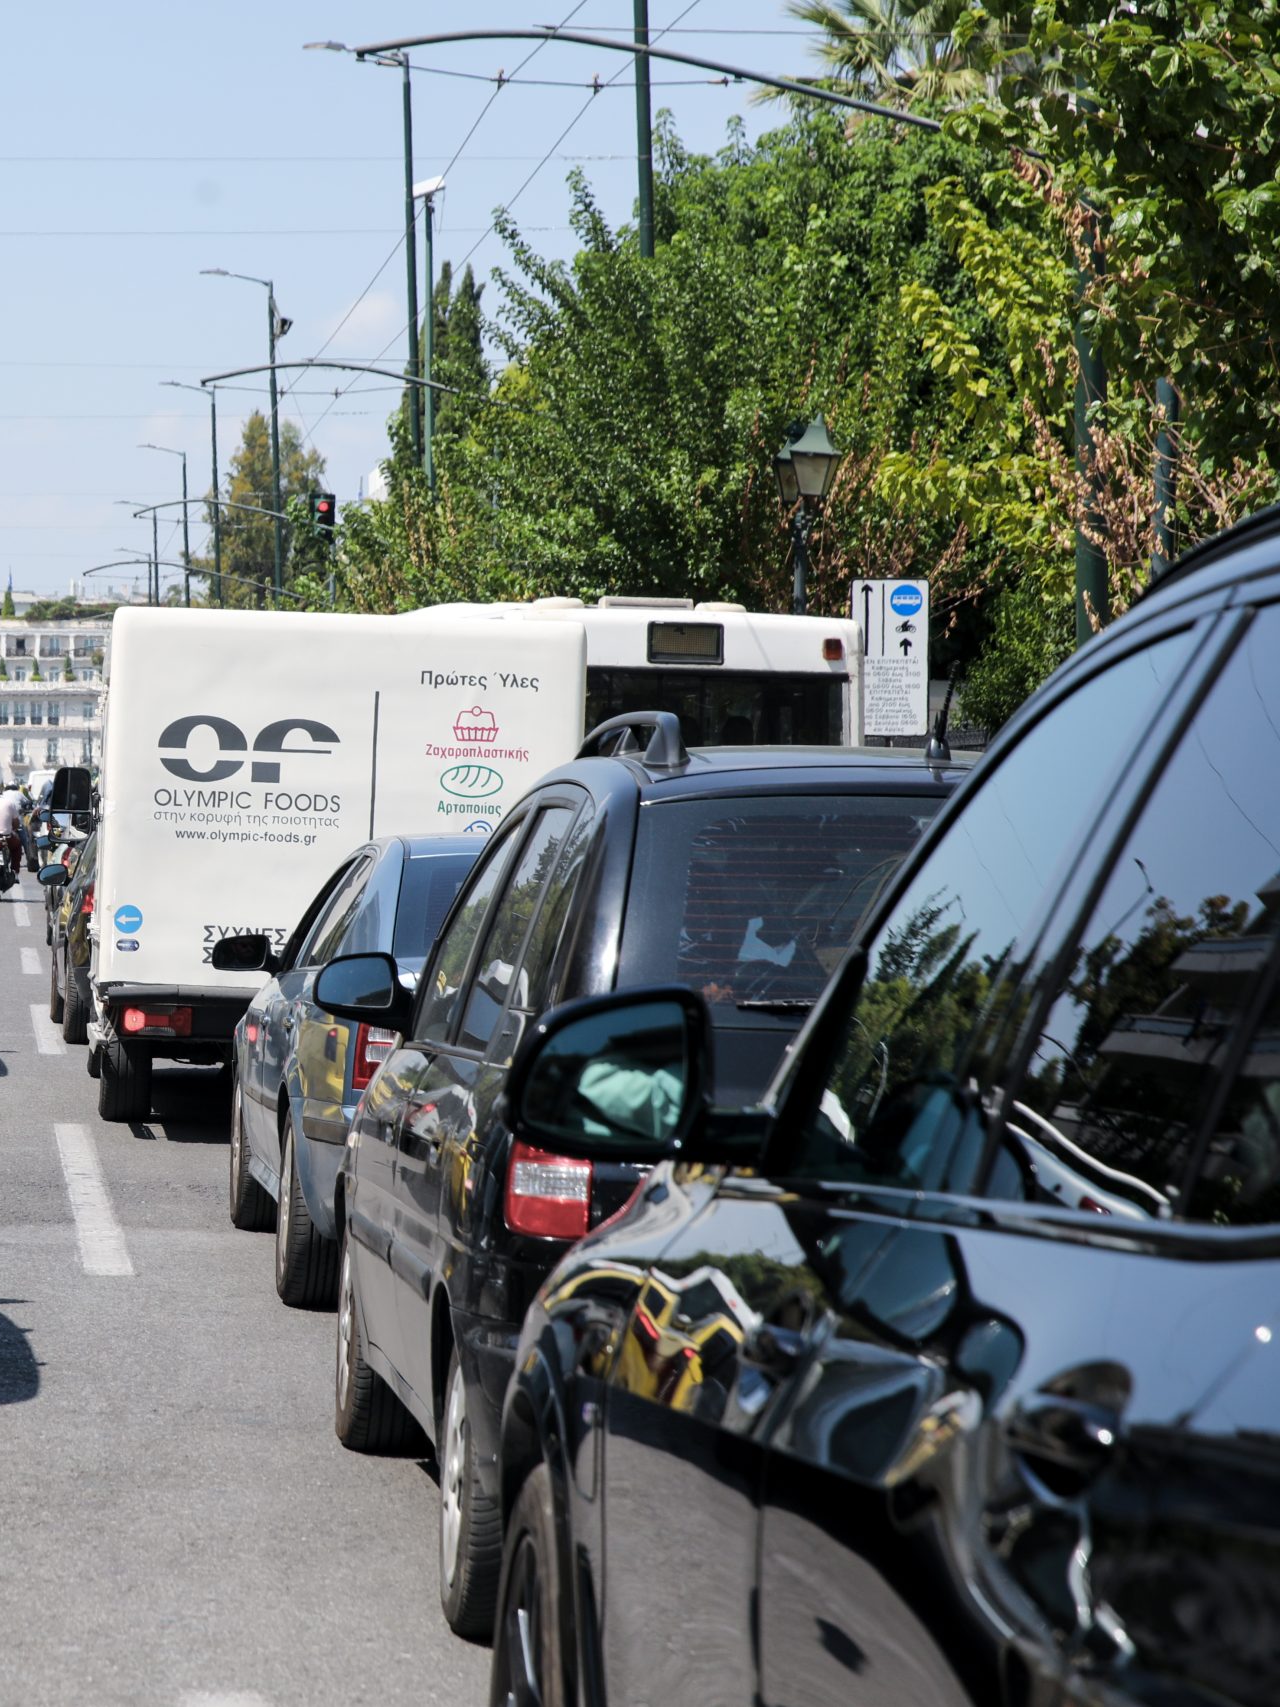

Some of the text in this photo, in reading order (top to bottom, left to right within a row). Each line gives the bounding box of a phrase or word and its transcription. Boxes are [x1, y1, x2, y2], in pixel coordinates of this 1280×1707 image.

[421, 670, 487, 690] Πρώτες
[425, 743, 529, 762] Ζαχαροπλαστικής
[154, 788, 341, 813] OLYMPIC FOODS
[153, 810, 186, 823] στην
[189, 812, 242, 826] κορυφή
[246, 813, 268, 827] της
[175, 829, 317, 846] www.olympic-foods.gr
